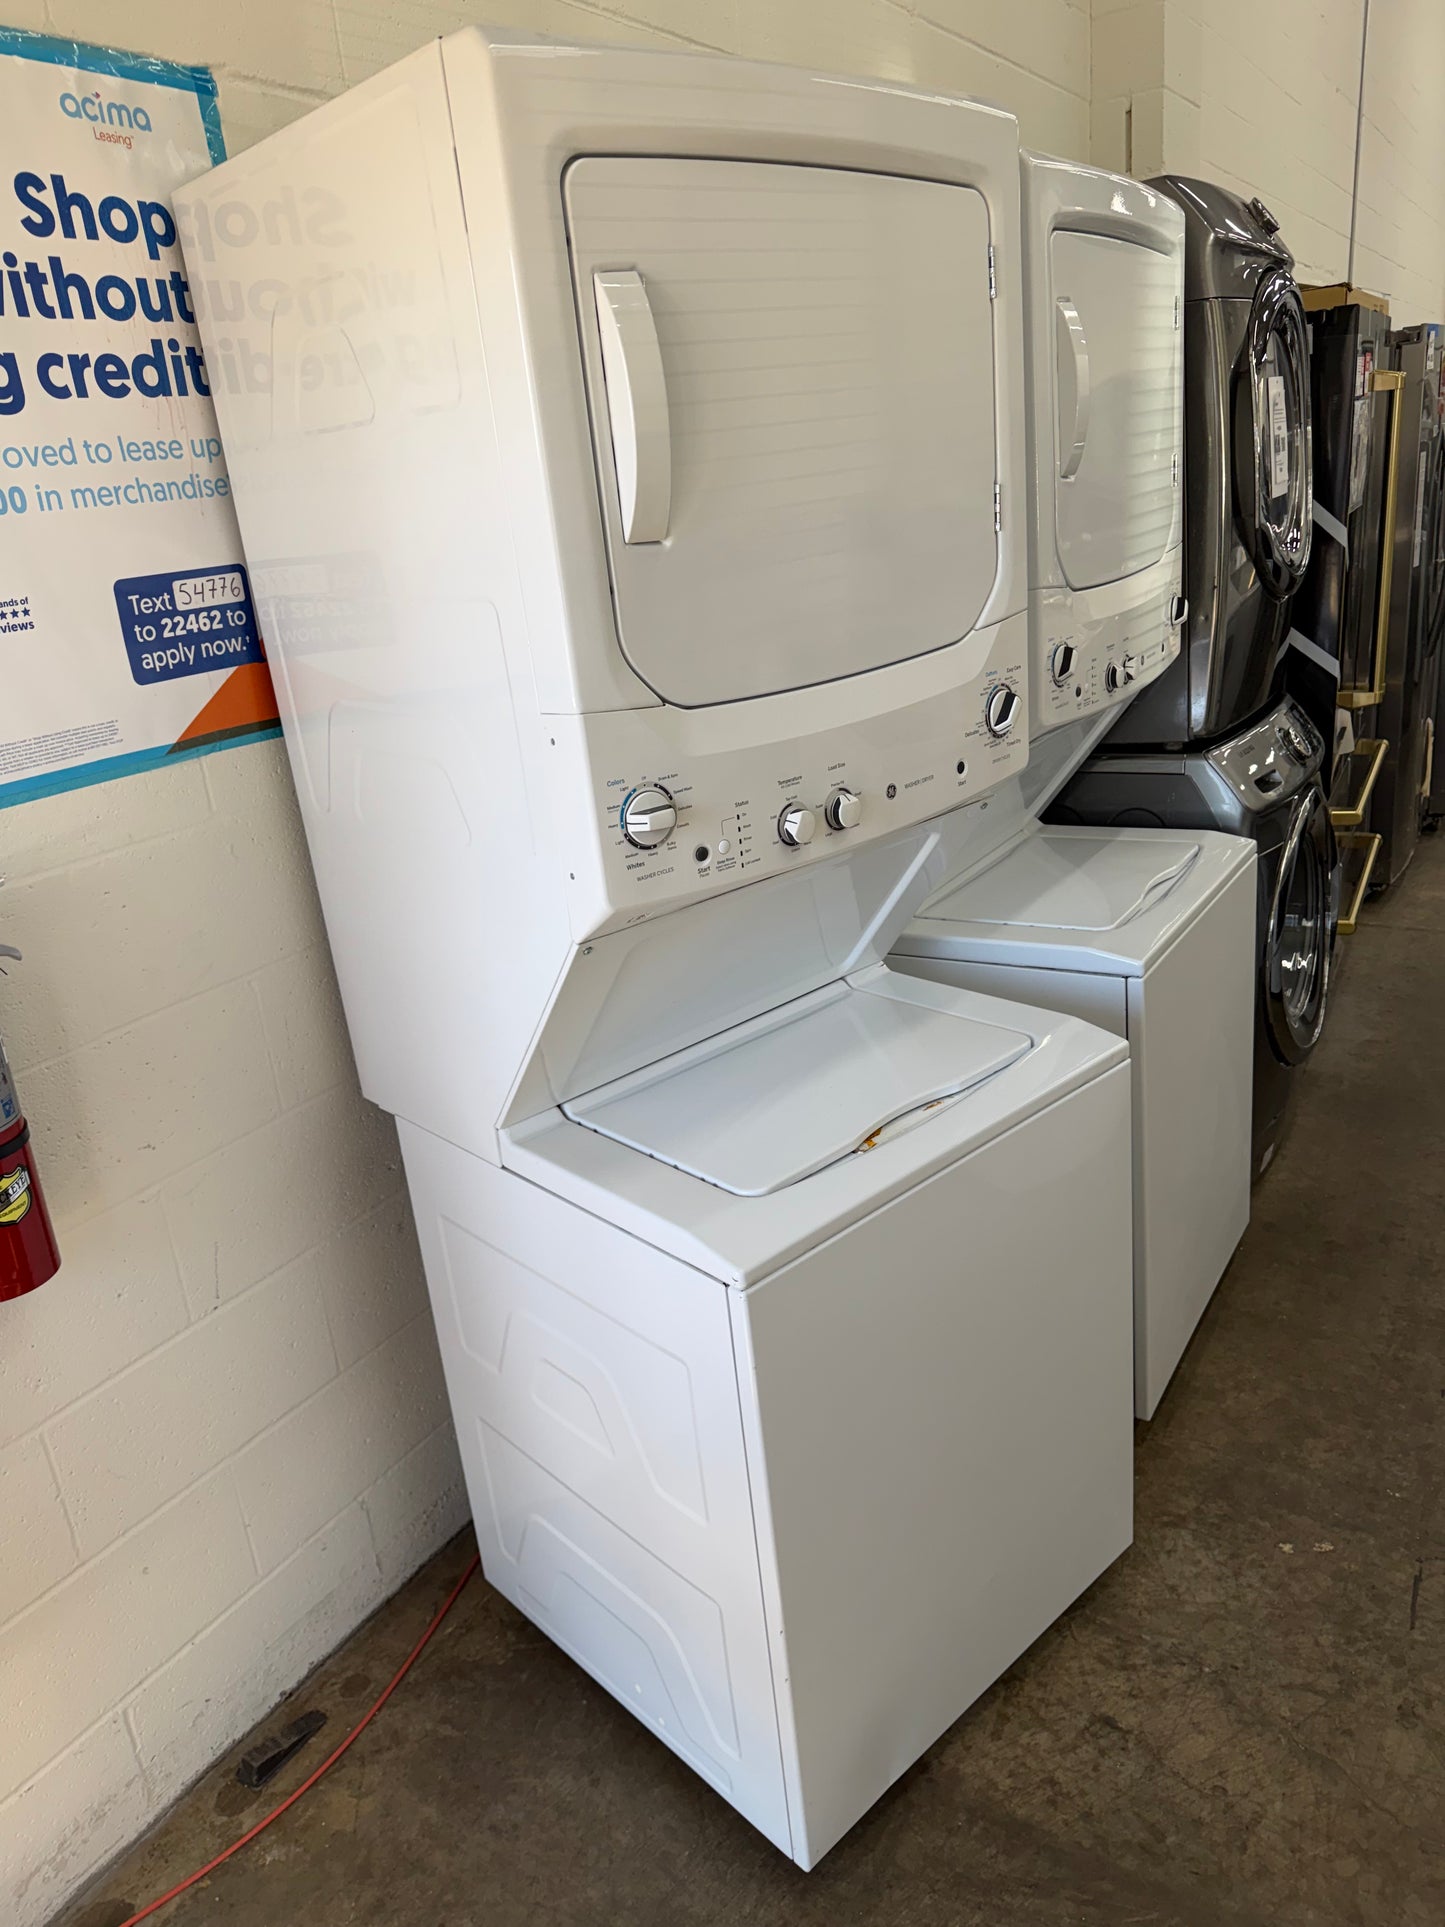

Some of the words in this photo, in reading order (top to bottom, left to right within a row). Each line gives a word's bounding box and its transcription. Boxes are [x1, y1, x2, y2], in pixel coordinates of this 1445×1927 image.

[60, 92, 152, 132] acima
[14, 171, 176, 260] Shop
[0, 251, 195, 324] ithout
[37, 338, 211, 400] credit
[83, 440, 113, 464] to
[117, 435, 183, 462] lease
[191, 438, 222, 463] up
[35, 484, 64, 512] in
[20, 596, 29, 606] of
[127, 593, 173, 616] Text
[178, 577, 241, 605] 54776
[134, 624, 157, 643] to
[161, 610, 224, 638] 22462
[226, 609, 247, 627] to
[141, 642, 195, 672] apply
[606, 778, 626, 788] Colors
[626, 861, 646, 872] Whites
[636, 872, 656, 882] WASHER
[656, 866, 675, 877] CYCLES
[697, 865, 711, 875] Start
